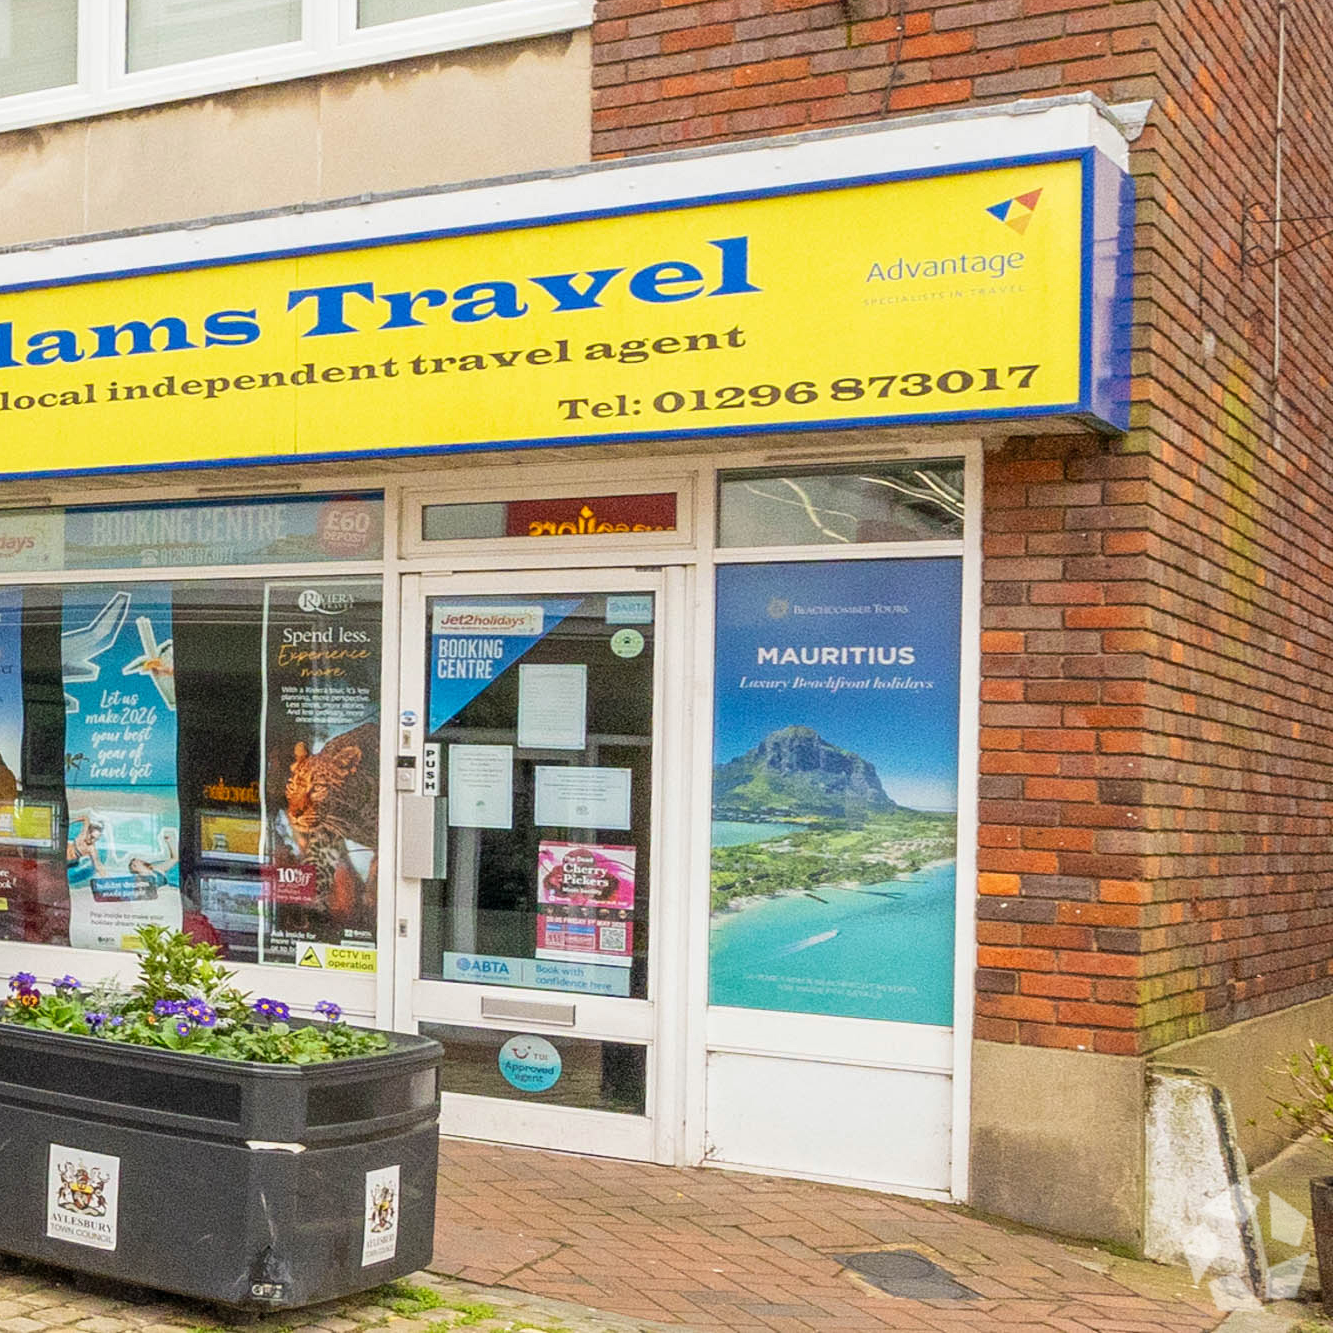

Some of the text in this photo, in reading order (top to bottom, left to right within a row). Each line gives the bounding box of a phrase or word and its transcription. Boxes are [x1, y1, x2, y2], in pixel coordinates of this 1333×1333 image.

[865, 249, 1026, 284] Advantage
[286, 235, 764, 339] Travel
[1, 382, 97, 412] local
[107, 355, 400, 403] independent
[413, 339, 570, 377] travel
[584, 324, 747, 365] agent
[557, 363, 1042, 421] Tel: 01296 873017
[324, 512, 371, 533] £60
[440, 612, 526, 629] Jet2holidays
[282, 626, 371, 647] Spend less.
[277, 644, 372, 667] Experience
[438, 638, 504, 659] BOOKING
[757, 646, 916, 665] MAURITIUS
[436, 658, 493, 680] CENTRE
[739, 675, 934, 694] Luxury Beachfront holidays
[100, 689, 139, 708] Let us
[84, 705, 157, 725] make 2026
[91, 725, 153, 749] your best
[97, 743, 145, 768] year of
[89, 762, 153, 785] travel yet
[425, 750, 436, 790] PUSH
[295, 872, 313, 886] off
[563, 863, 608, 878] Cherry
[563, 874, 609, 887] Pickers
[306, 932, 317, 940] for
[327, 958, 374, 971] operation
[331, 949, 371, 961] CCTV in
[469, 961, 510, 974] ABTA
[535, 963, 585, 978] Book with
[535, 975, 613, 991] confidence here
[533, 1052, 548, 1061] TUI
[504, 1061, 555, 1076] Approved
[514, 1074, 543, 1085] agent
[50, 1222, 114, 1244] TOWN COUNCIL
[51, 1213, 112, 1234] AYLESBURY
